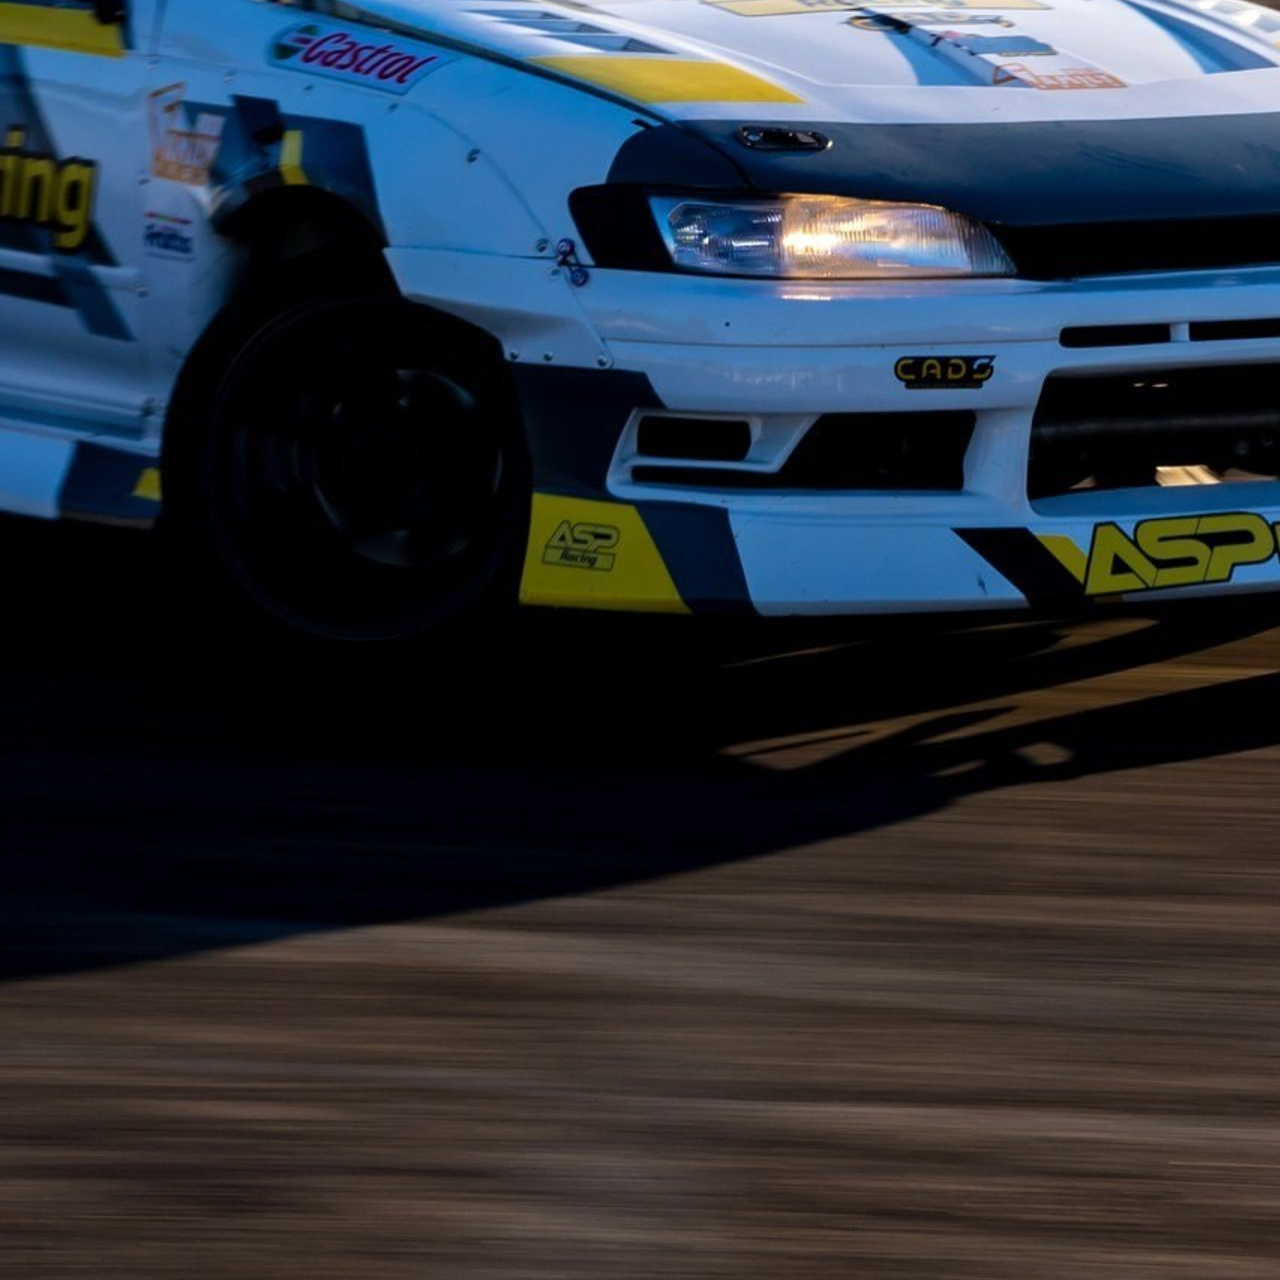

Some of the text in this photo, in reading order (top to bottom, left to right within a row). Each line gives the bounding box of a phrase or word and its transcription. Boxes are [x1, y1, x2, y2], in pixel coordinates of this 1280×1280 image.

[300, 32, 439, 84] Castrol
[895, 356, 994, 381] CADS
[546, 520, 620, 551] ASP
[561, 549, 597, 568] Racing
[1083, 511, 1276, 596] ASP
